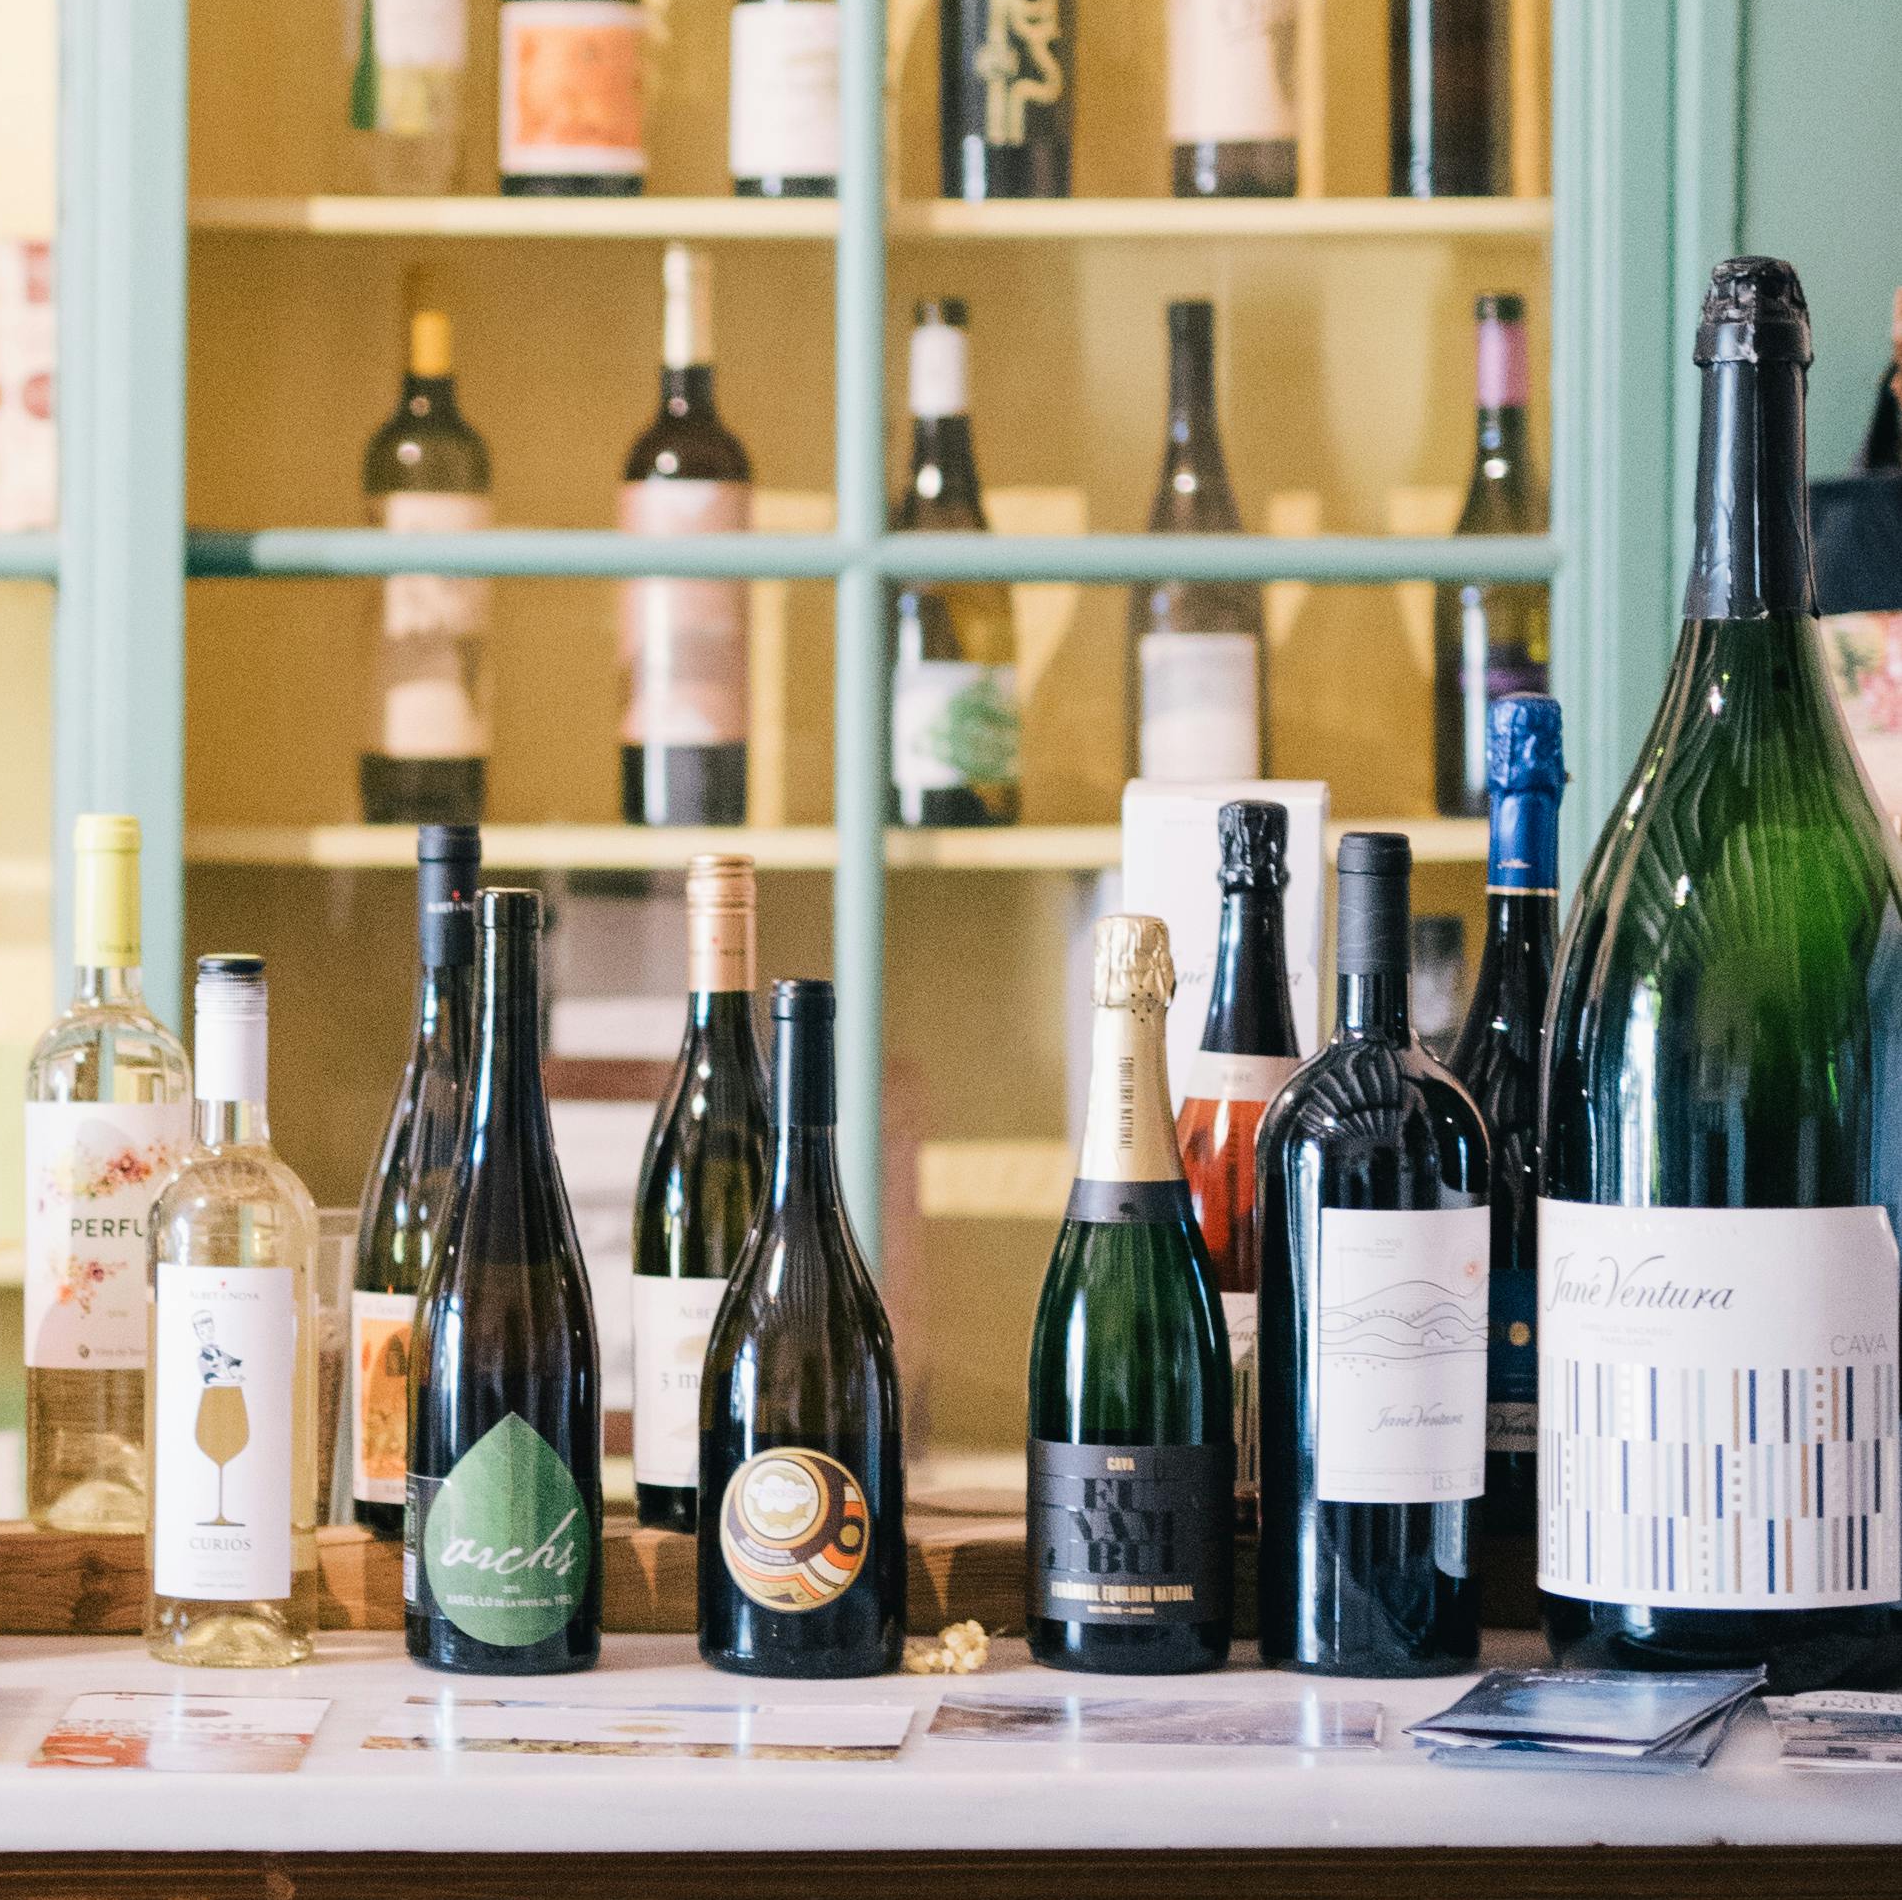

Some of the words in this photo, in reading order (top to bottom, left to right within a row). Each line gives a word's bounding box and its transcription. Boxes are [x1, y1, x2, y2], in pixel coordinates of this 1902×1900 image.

[1546, 1251, 1601, 1311] Jané
[1598, 1254, 1736, 1310] Ventura
[1829, 1332, 1889, 1357] CAVA
[188, 1532, 253, 1552] CURIÓS
